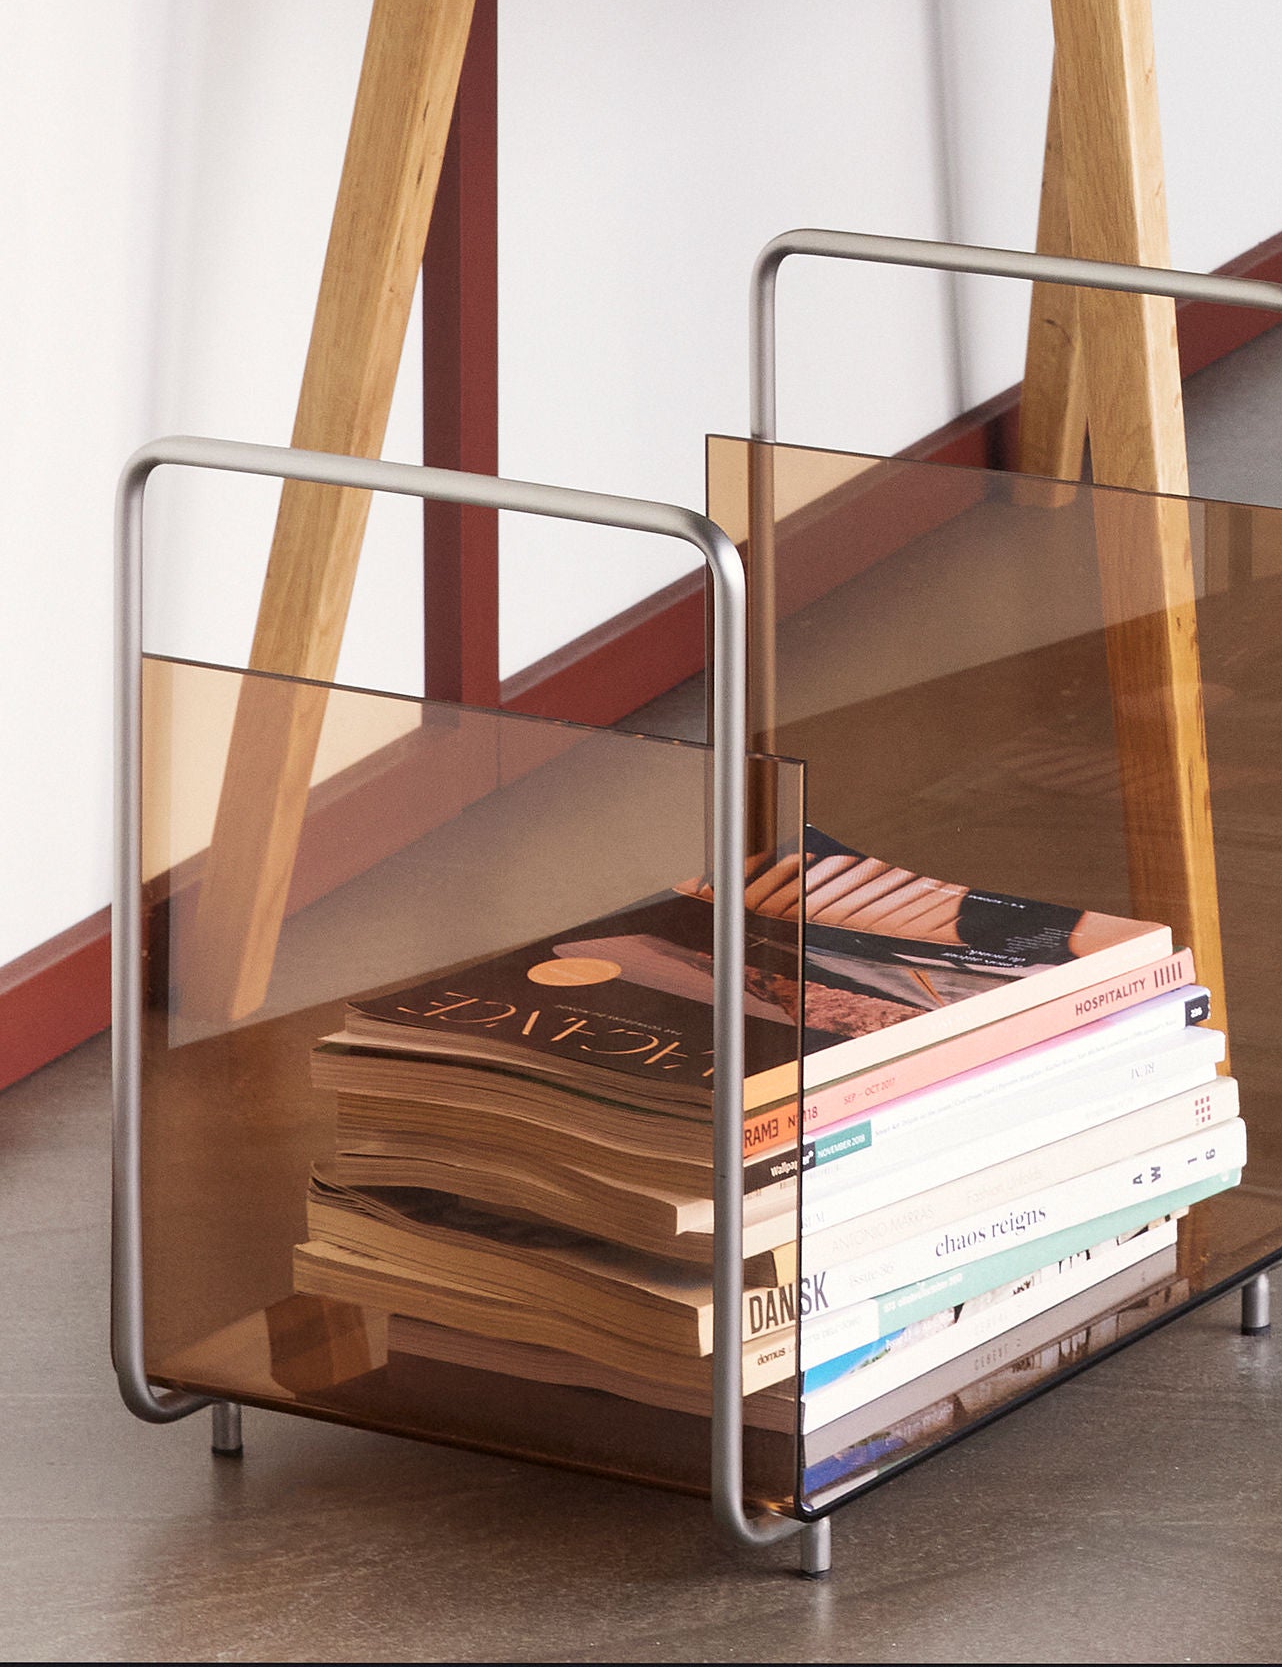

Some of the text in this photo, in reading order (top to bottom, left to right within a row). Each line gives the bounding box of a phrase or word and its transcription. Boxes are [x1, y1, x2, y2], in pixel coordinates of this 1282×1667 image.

[1075, 977, 1147, 1017] HOSPITALITY
[749, 1270, 829, 1335] DANSK
[935, 1227, 987, 1257] chaos
[991, 1205, 1047, 1236] reigns
[757, 1347, 786, 1366] domus
